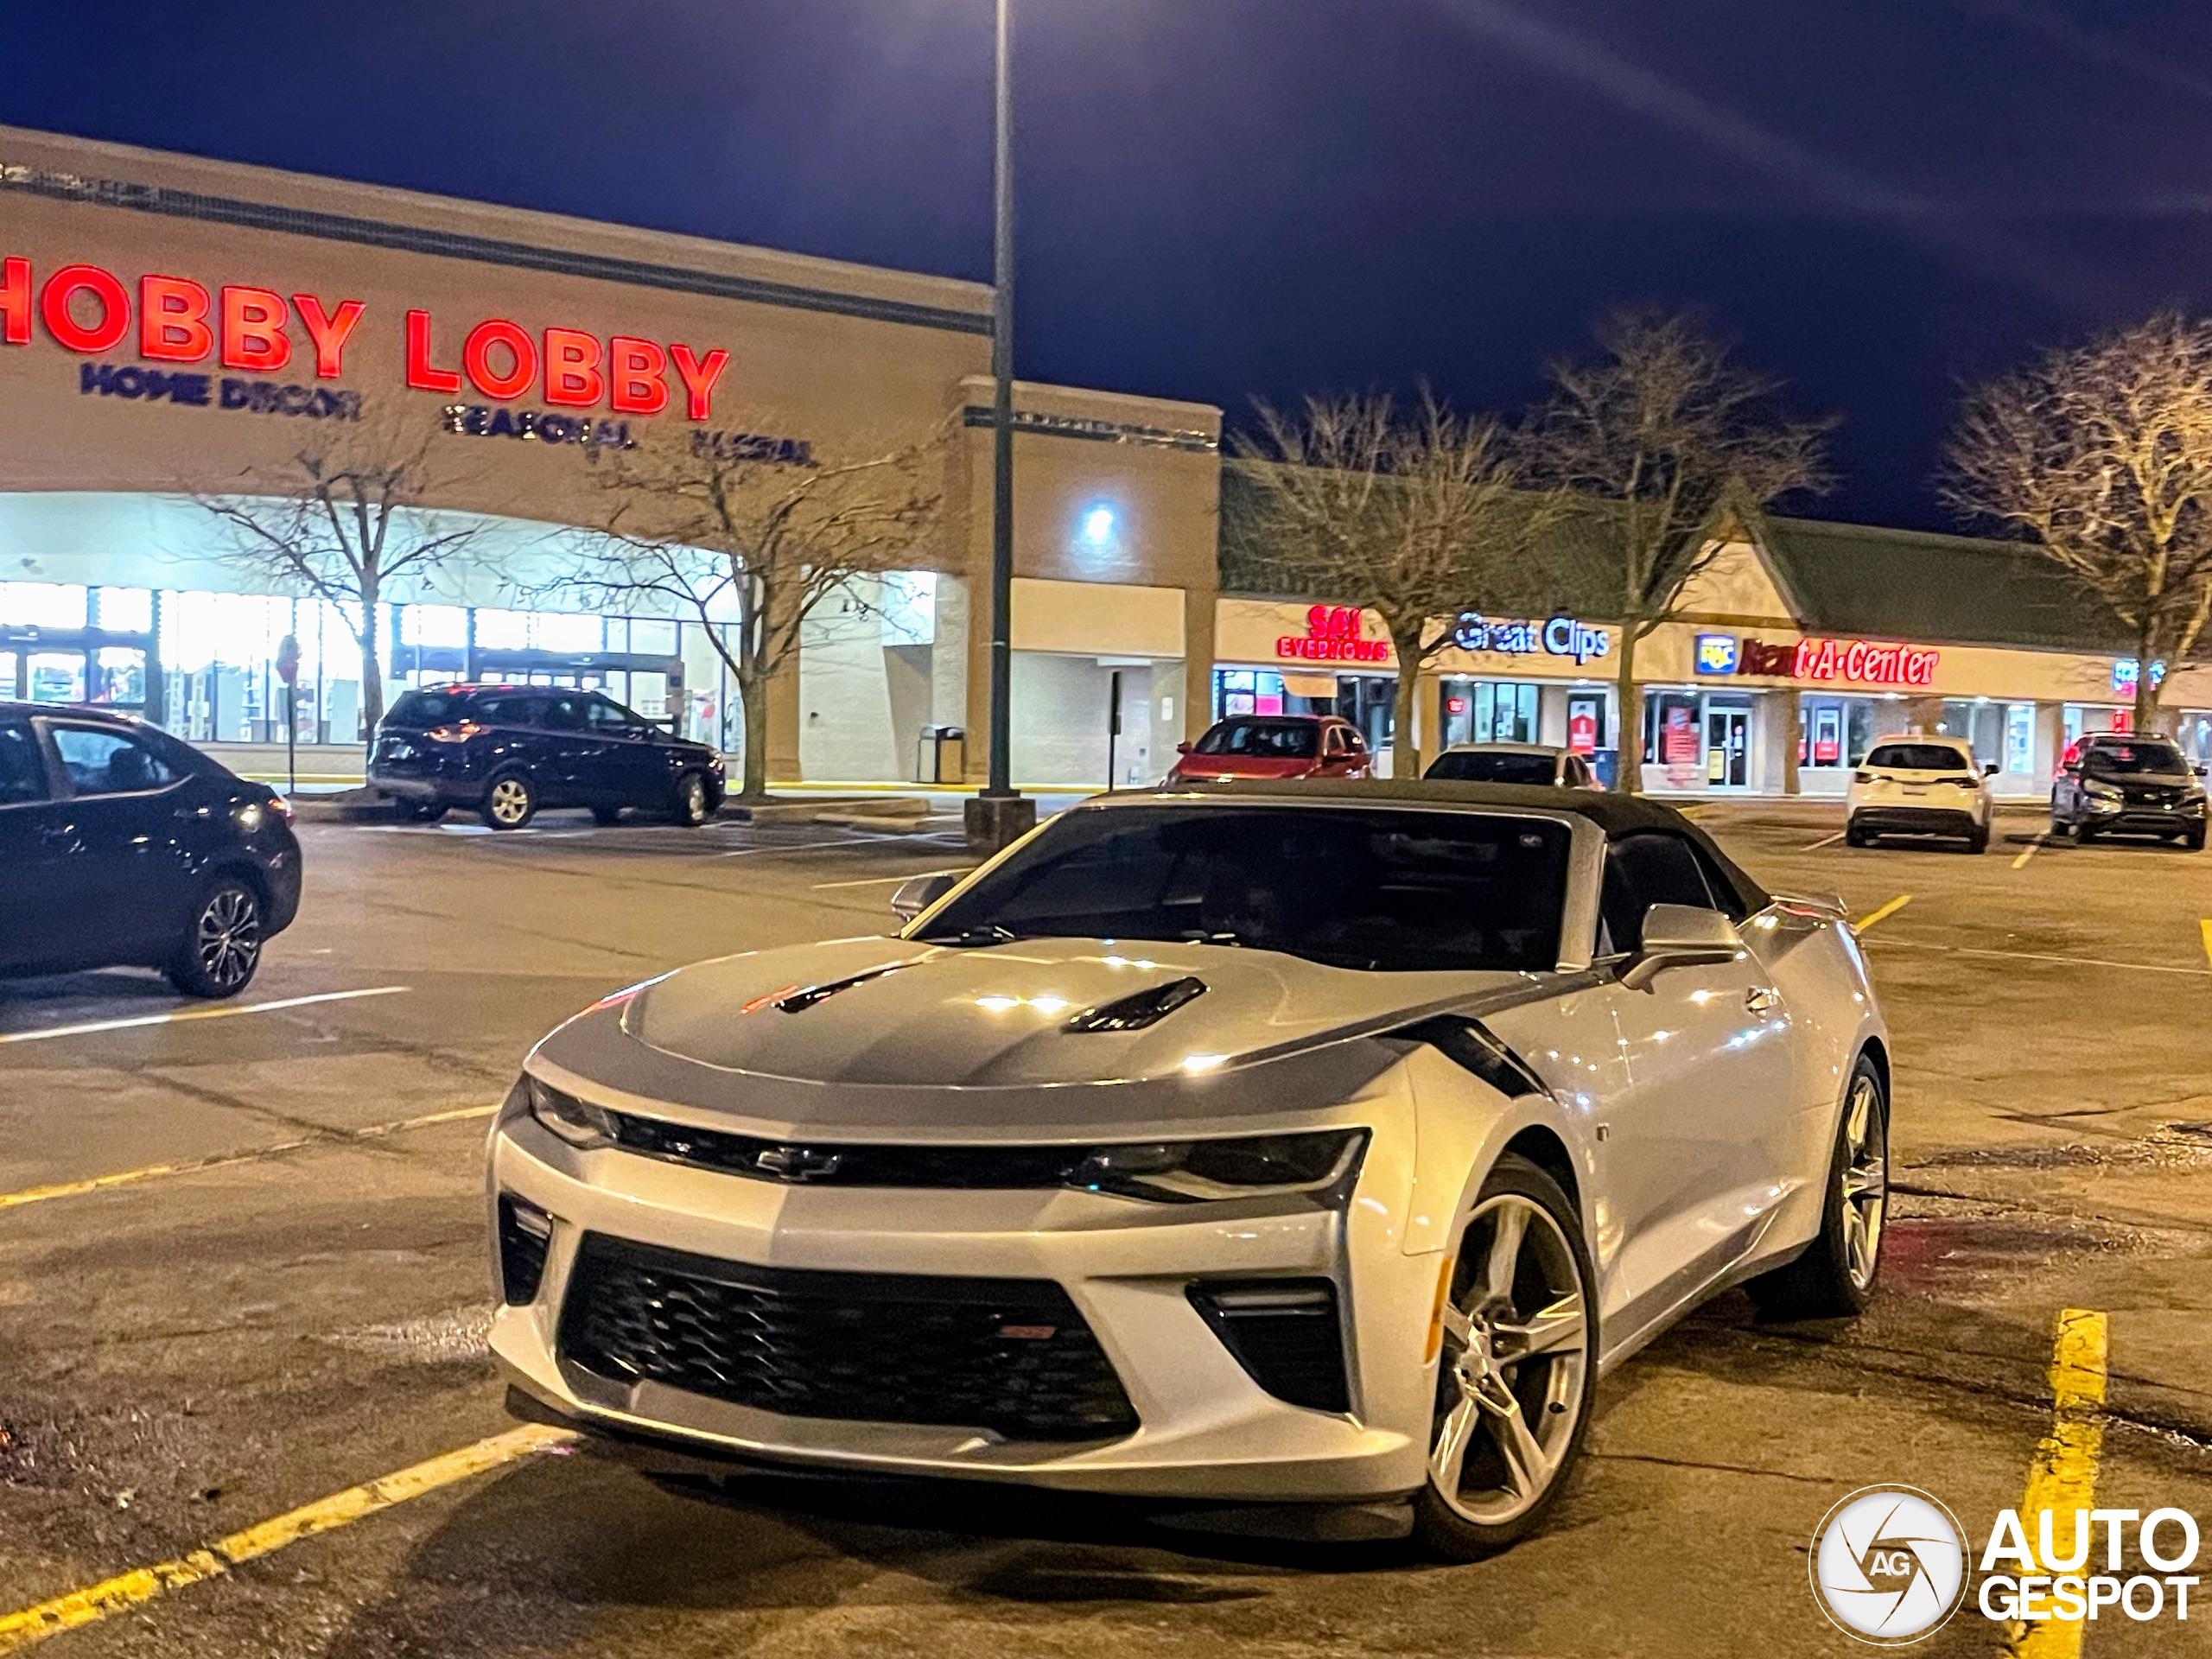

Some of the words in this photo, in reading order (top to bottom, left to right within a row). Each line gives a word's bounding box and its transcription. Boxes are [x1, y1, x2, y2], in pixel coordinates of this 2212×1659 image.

[80, 362, 213, 406] HOME
[406, 309, 730, 421] LOBBY
[1455, 611, 1538, 652] Great
[1543, 615, 1610, 665] Clips
